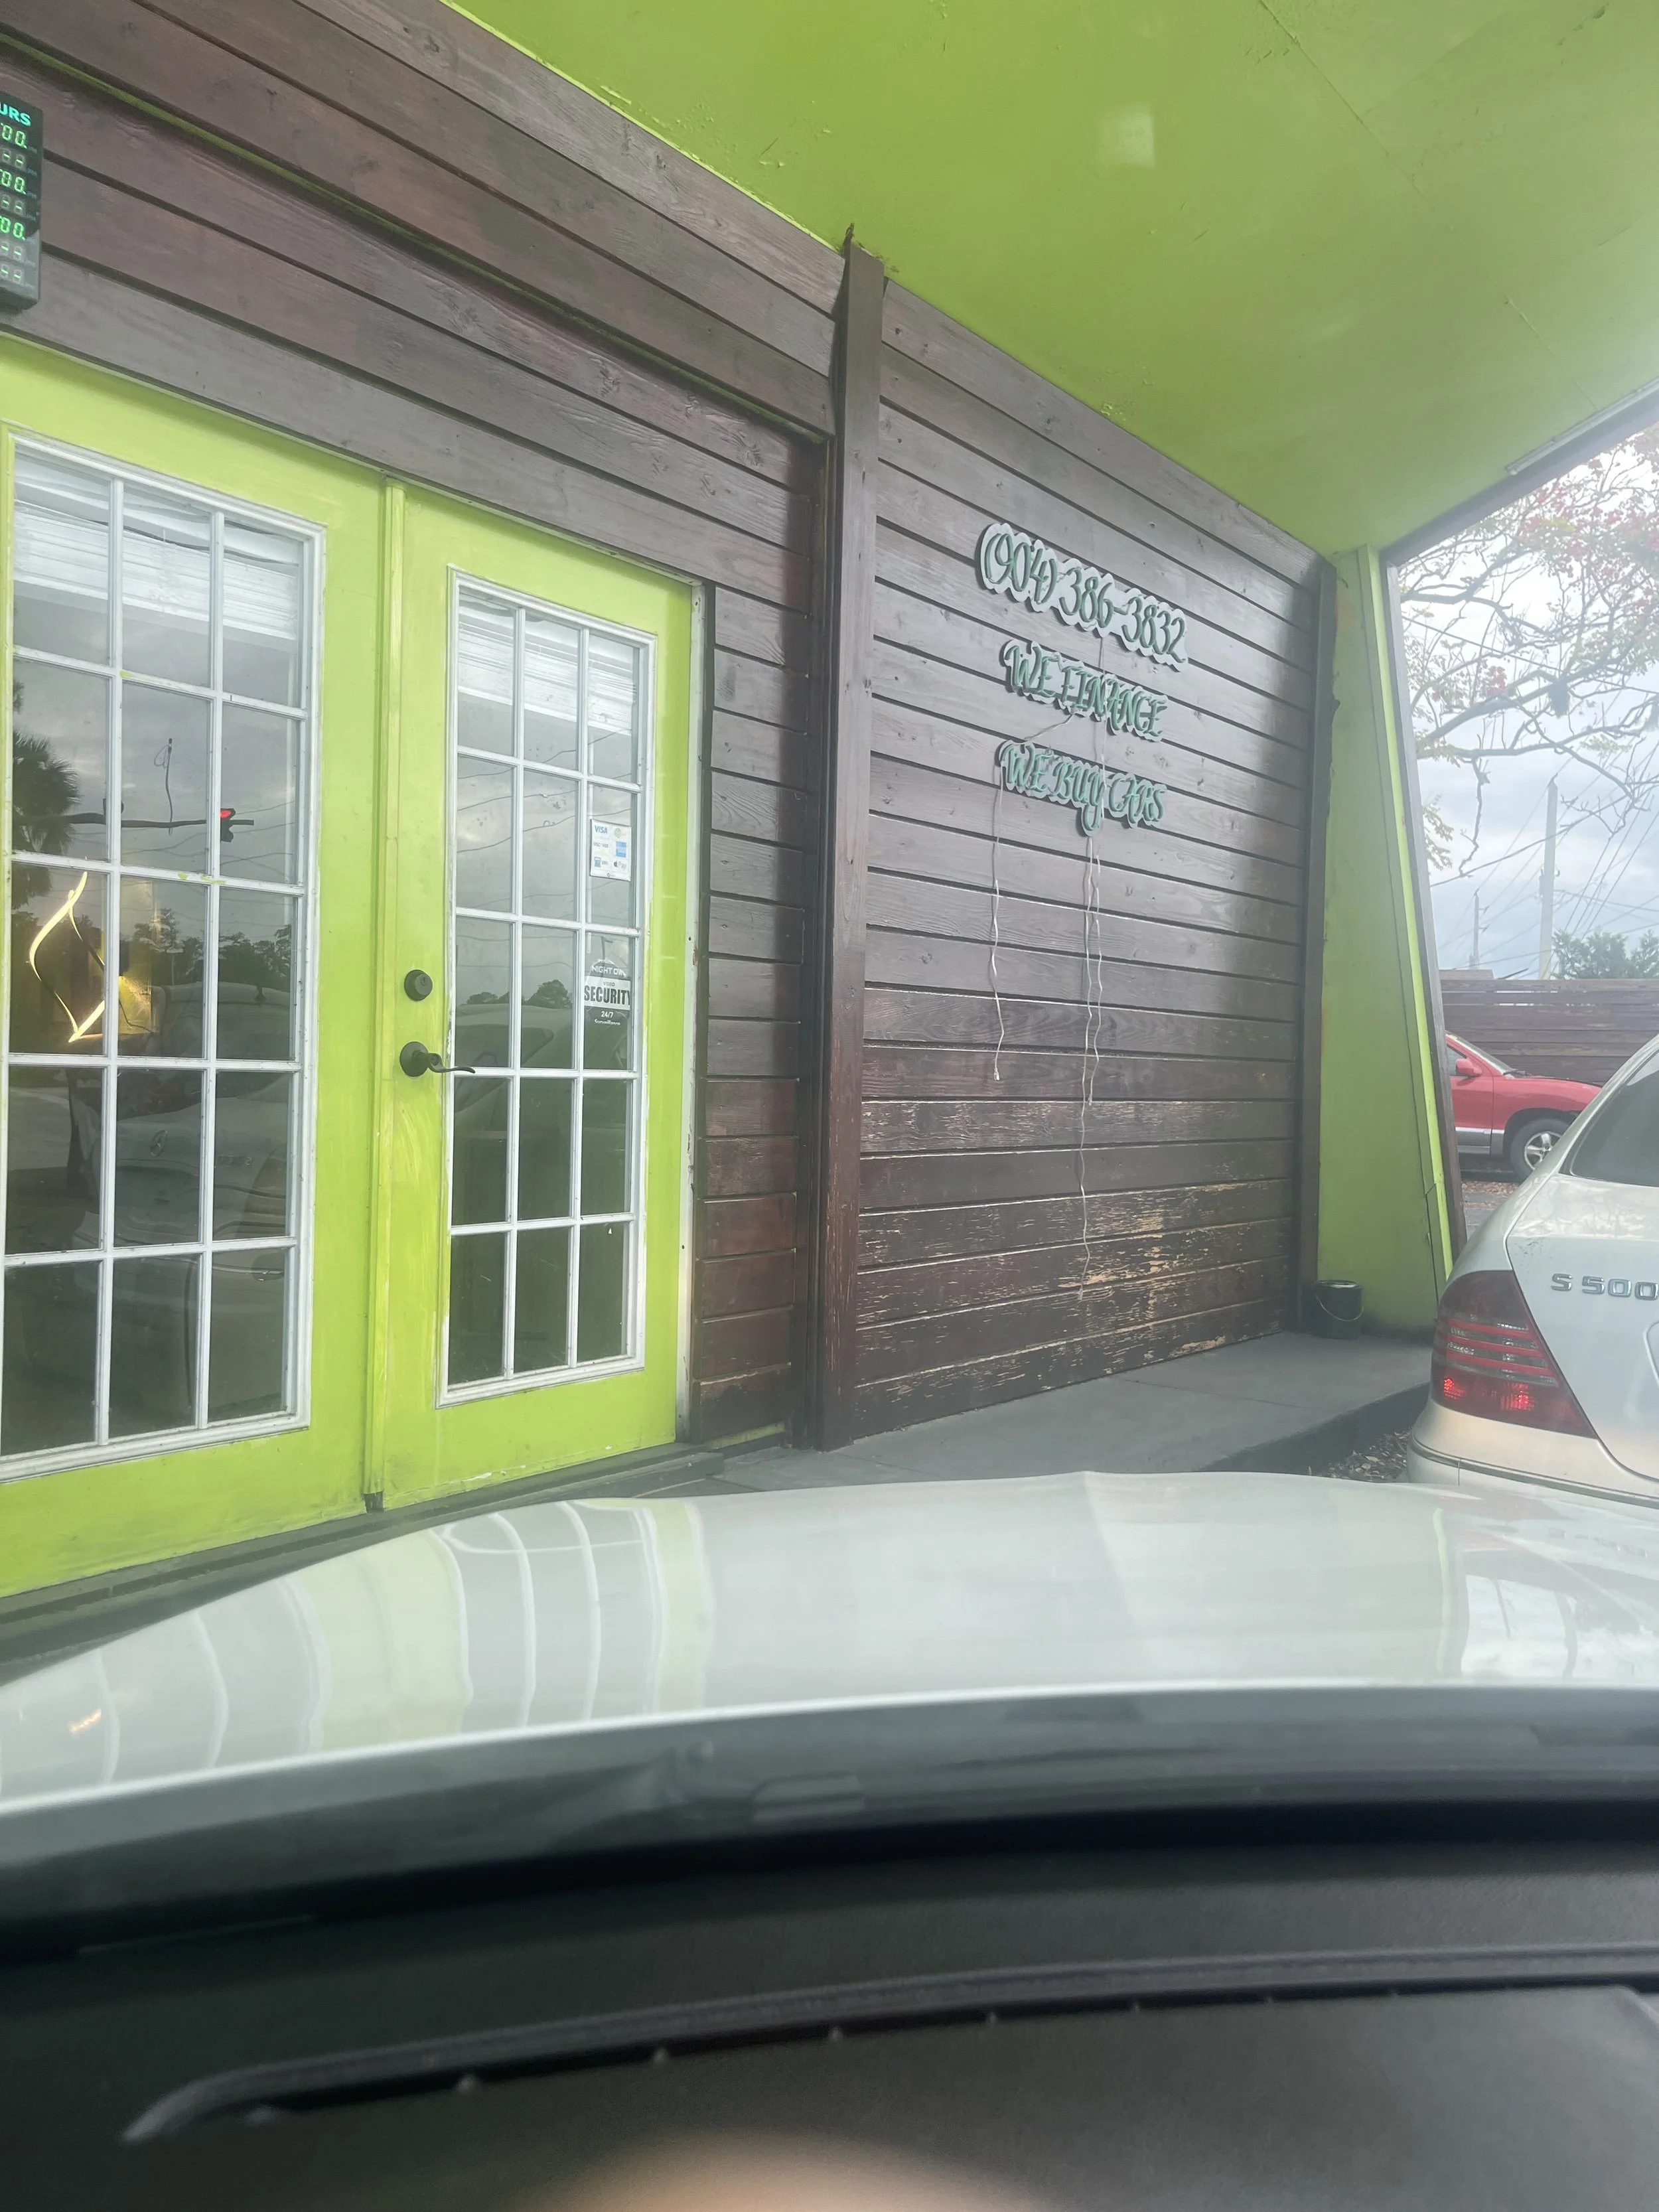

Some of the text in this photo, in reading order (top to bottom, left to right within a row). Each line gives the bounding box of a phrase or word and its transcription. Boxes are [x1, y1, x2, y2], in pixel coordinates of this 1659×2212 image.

[984, 533, 1187, 663] (904) 386-3832
[1004, 644, 1168, 737] WE FINANCE
[1000, 741, 1054, 792] WE
[595, 826, 608, 834] VISA
[1581, 1275, 1659, 1301] 500
